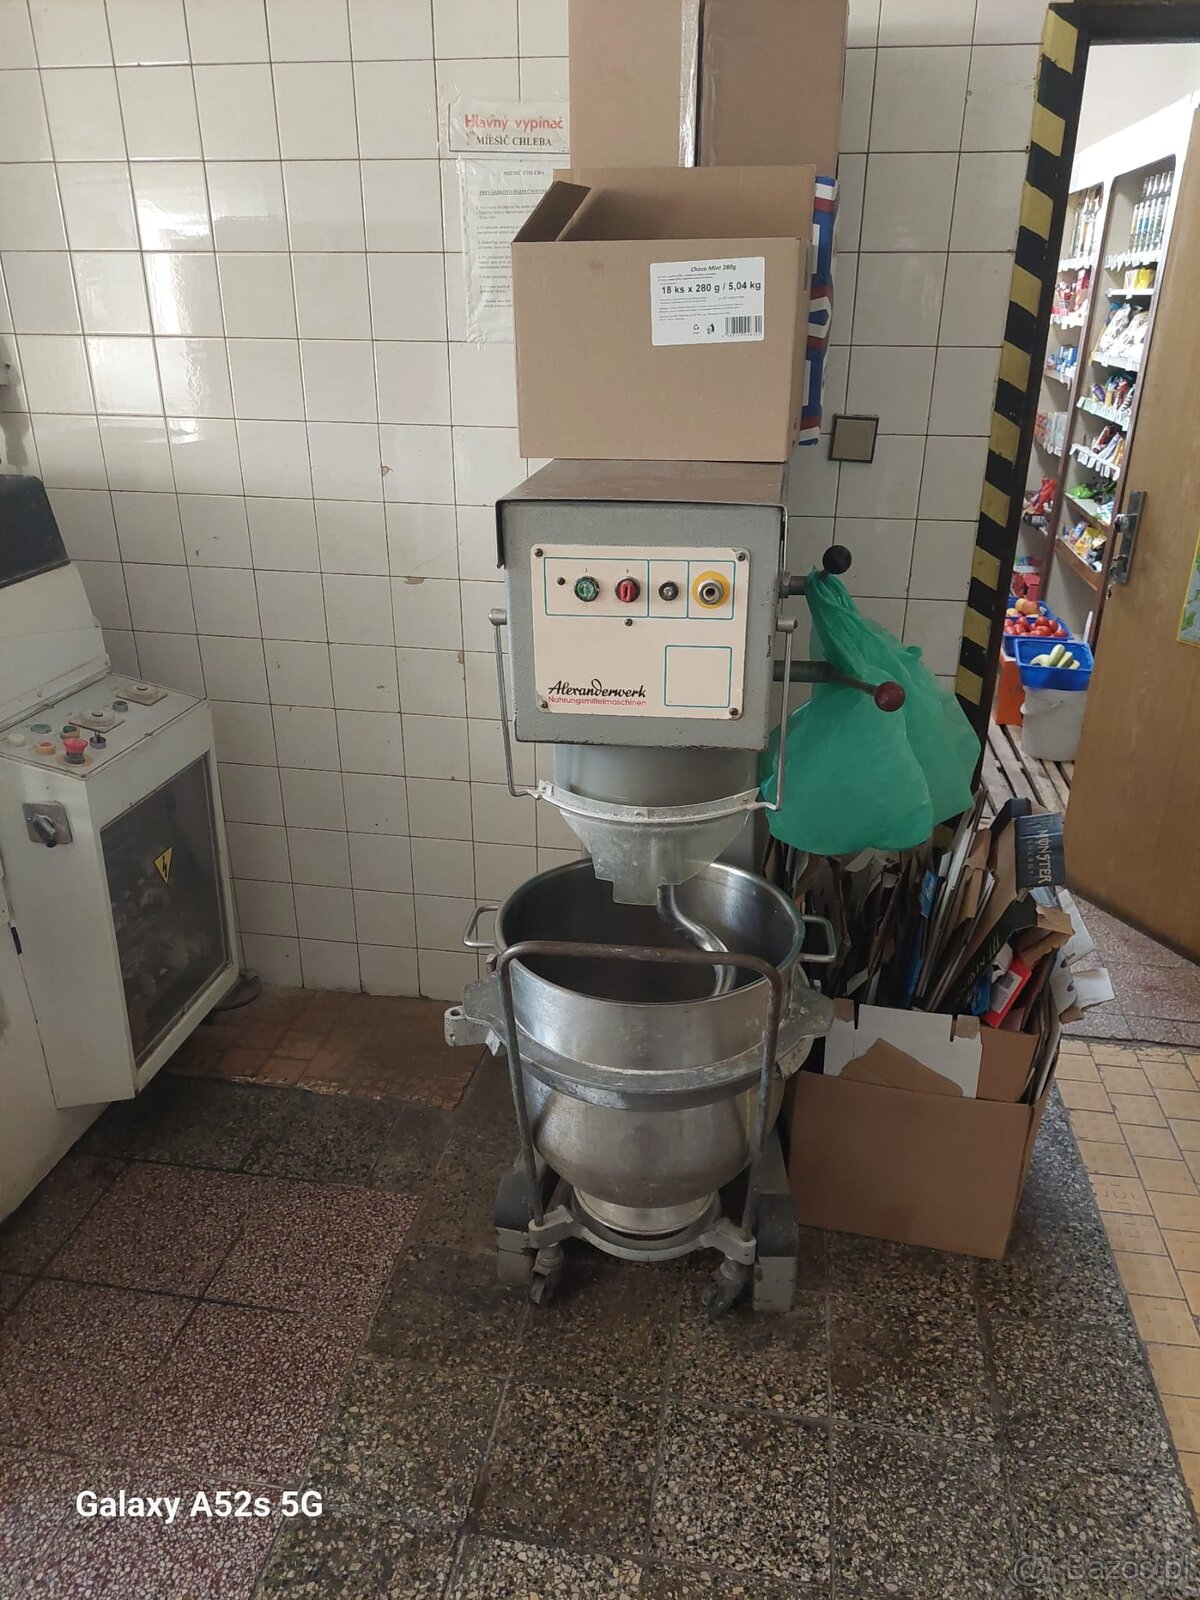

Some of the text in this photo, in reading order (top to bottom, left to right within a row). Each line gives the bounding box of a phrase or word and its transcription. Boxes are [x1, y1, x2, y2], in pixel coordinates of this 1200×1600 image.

[464, 113, 564, 132] Hlavný vypínač
[512, 136, 552, 147] CHLEBA
[661, 285, 672, 294] 18
[674, 285, 685, 294] ks
[695, 283, 711, 293] 280
[714, 284, 720, 293] g
[728, 281, 747, 291] 5,04
[749, 281, 761, 291] kg
[548, 678, 647, 698] Alexanderwerk
[548, 696, 647, 706] Nahrungsmittelmaschinen
[1034, 829, 1053, 884] MONSTER
